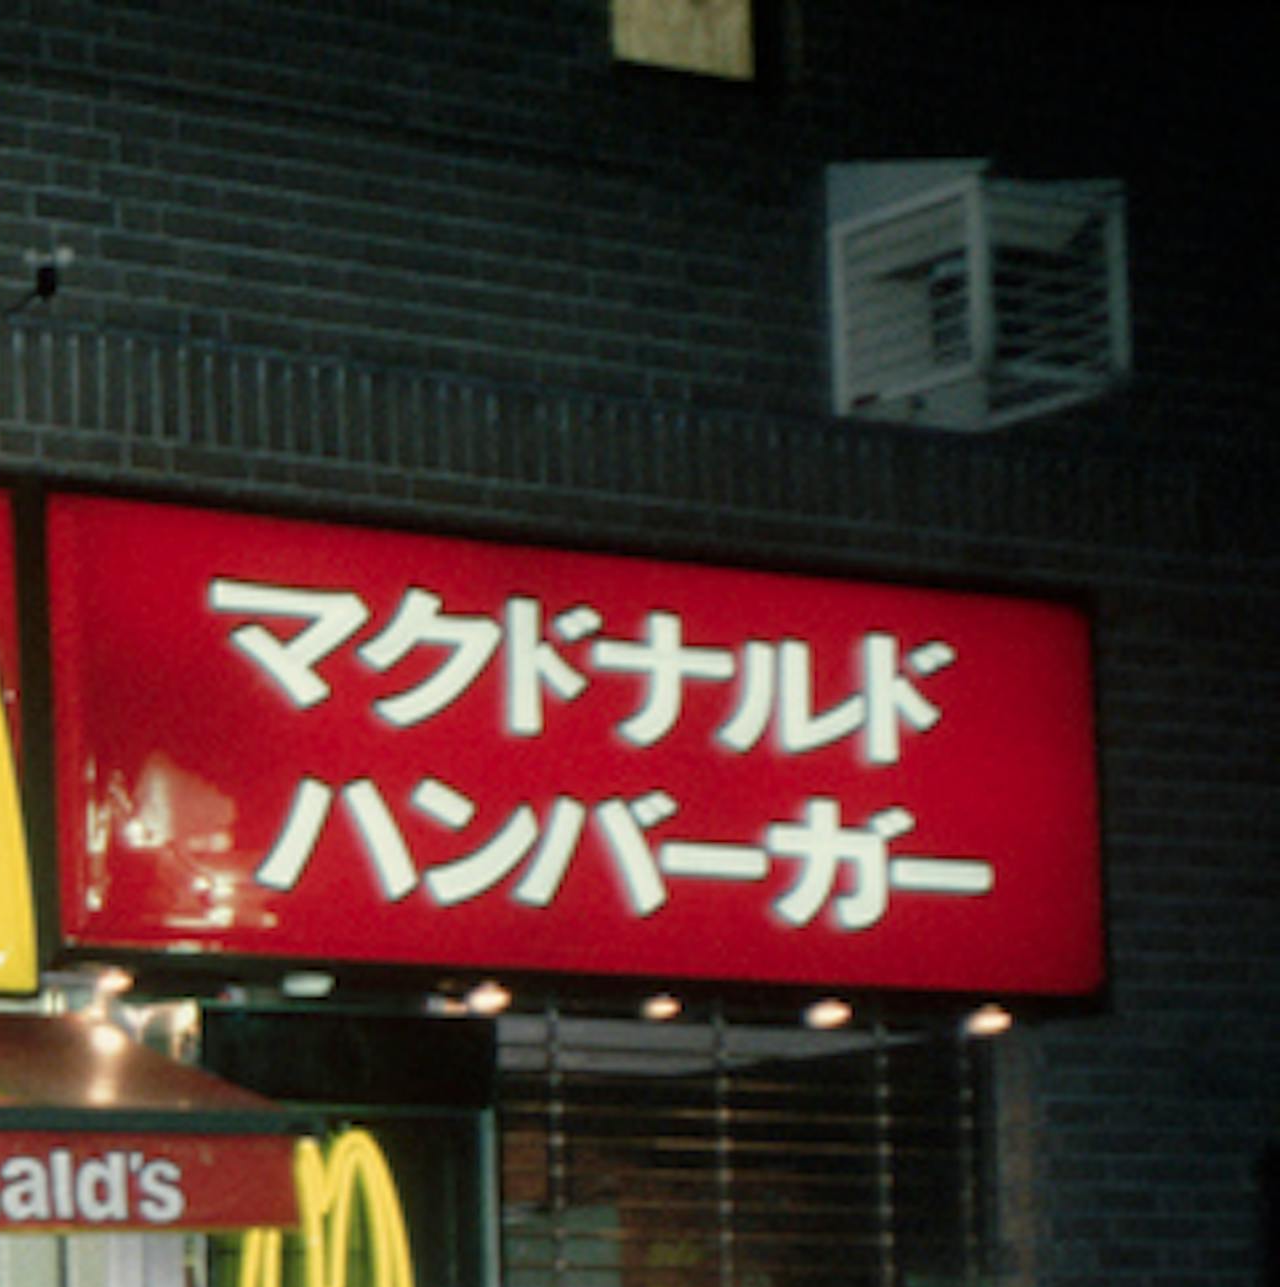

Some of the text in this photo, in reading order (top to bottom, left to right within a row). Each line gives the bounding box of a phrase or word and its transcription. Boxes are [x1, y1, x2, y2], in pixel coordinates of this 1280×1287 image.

[207, 577, 956, 766] マクドナルド
[255, 778, 994, 930] ハンバーガー
